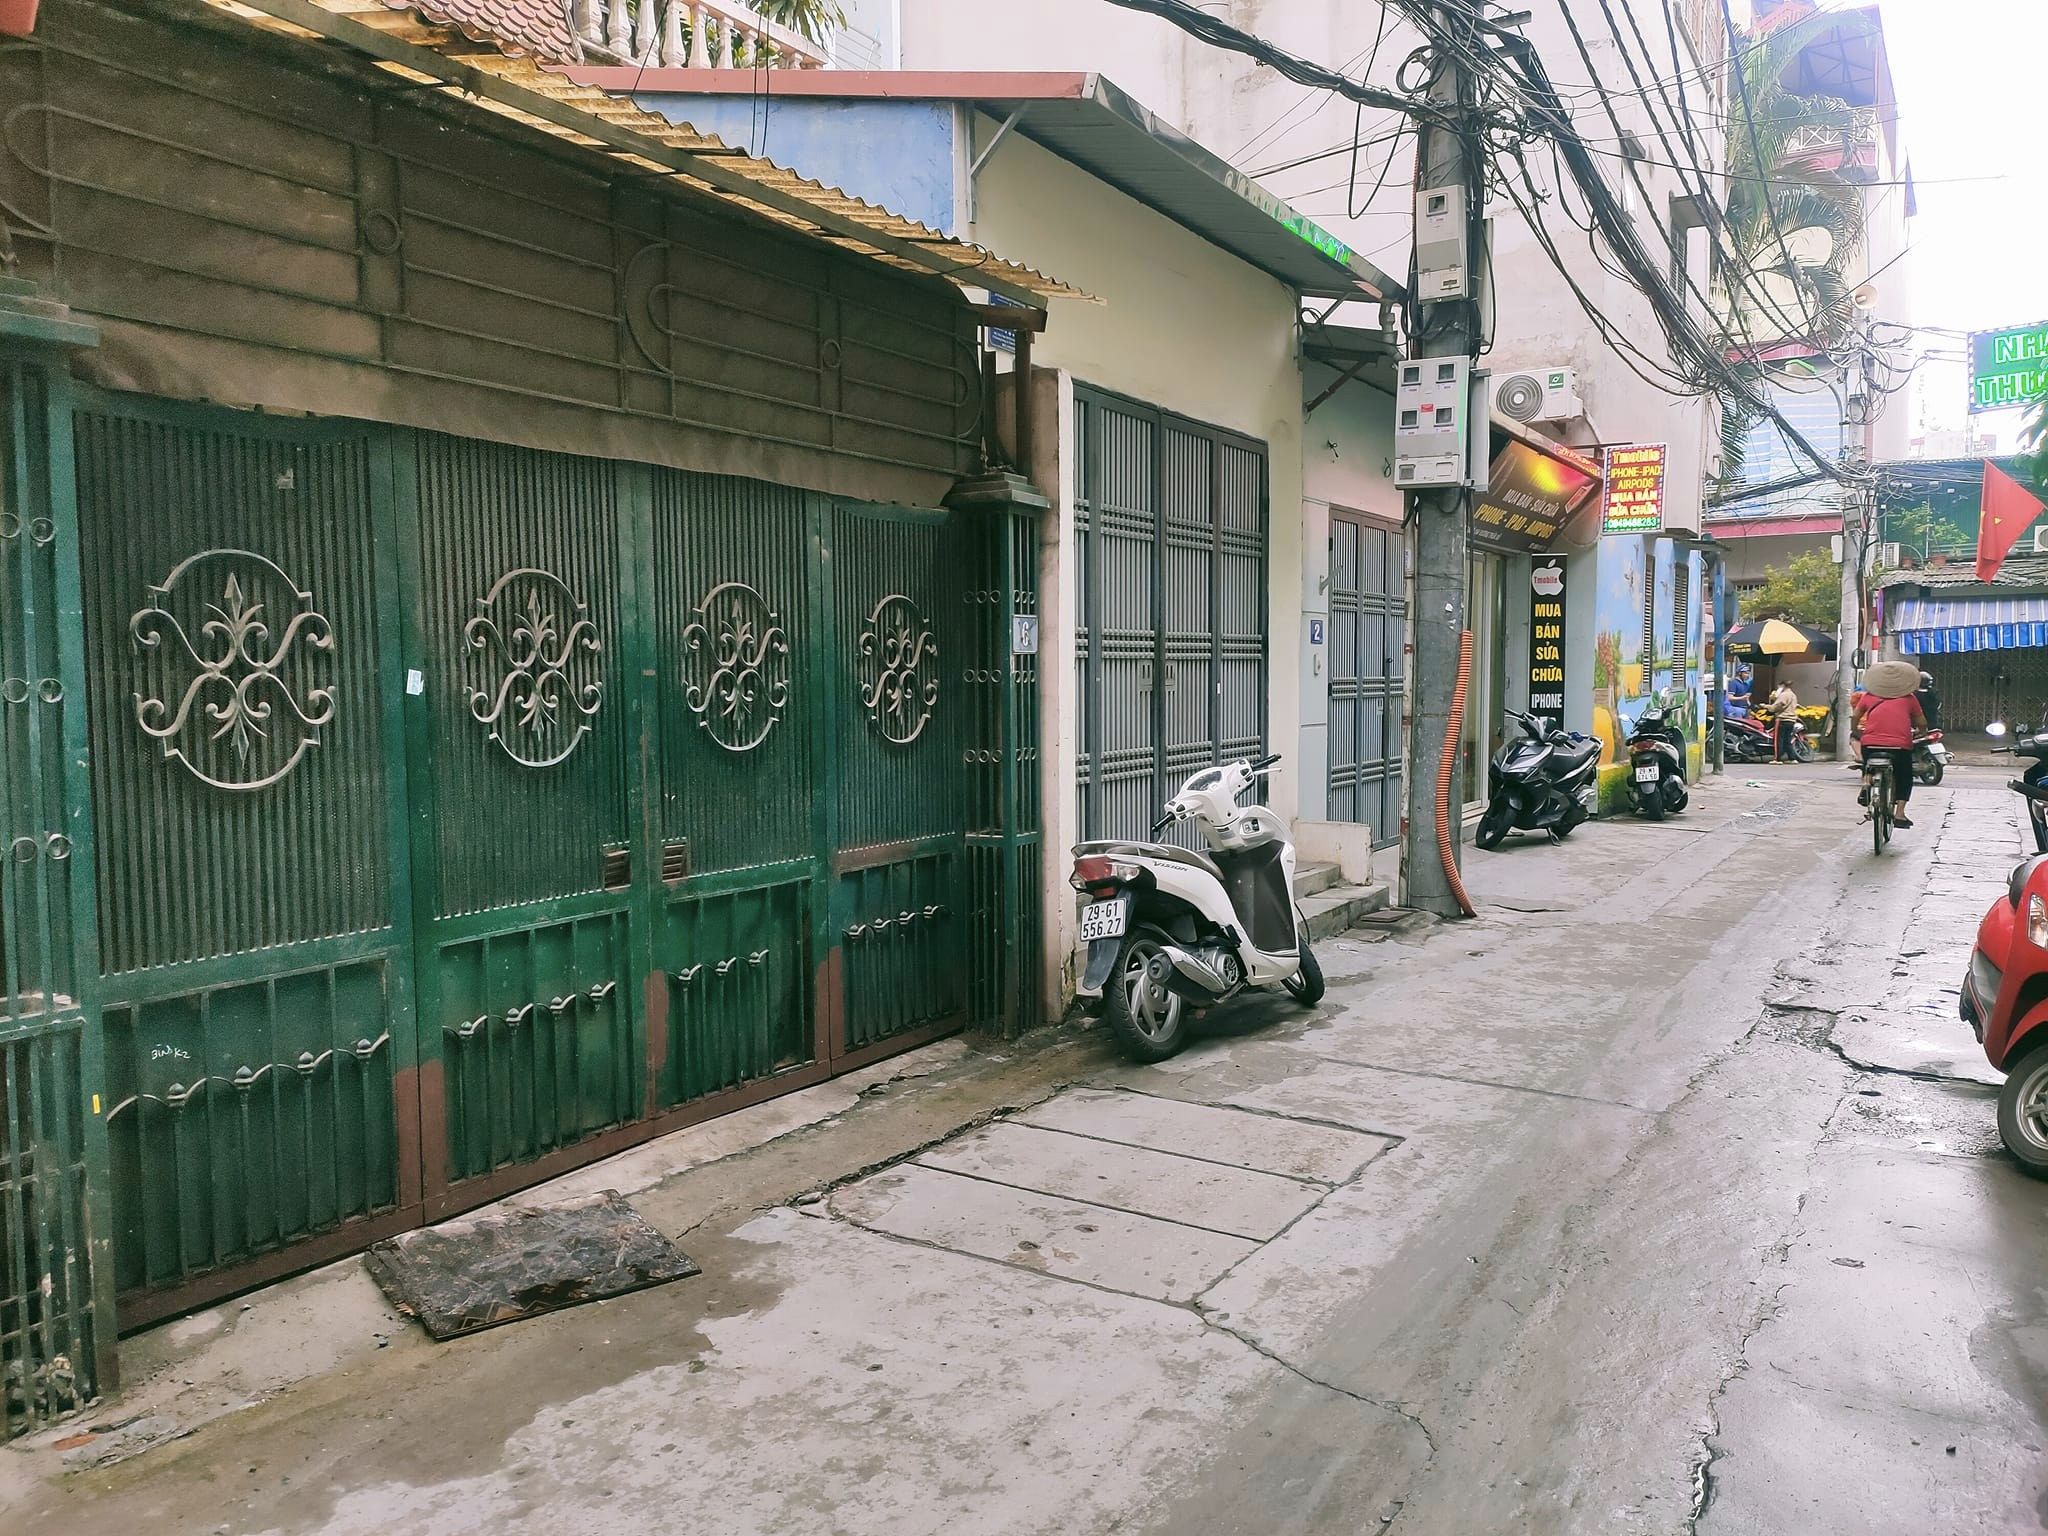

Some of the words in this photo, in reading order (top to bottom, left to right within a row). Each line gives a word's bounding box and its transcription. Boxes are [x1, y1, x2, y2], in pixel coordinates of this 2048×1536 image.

[1617, 478, 1654, 490] AIRPODS
[1473, 503, 1507, 525] IPHONE
[1505, 513, 1528, 532] IPAD
[1535, 603, 1561, 617] MUA
[1314, 623, 1321, 641] 2
[1535, 622, 1560, 639] BÁN
[1535, 641, 1560, 660] SỬA
[1532, 664, 1563, 682] CHỮA
[1531, 693, 1562, 709] IPHONE
[1087, 901, 1118, 921] 29-G1
[1082, 918, 1121, 939] 556.27
